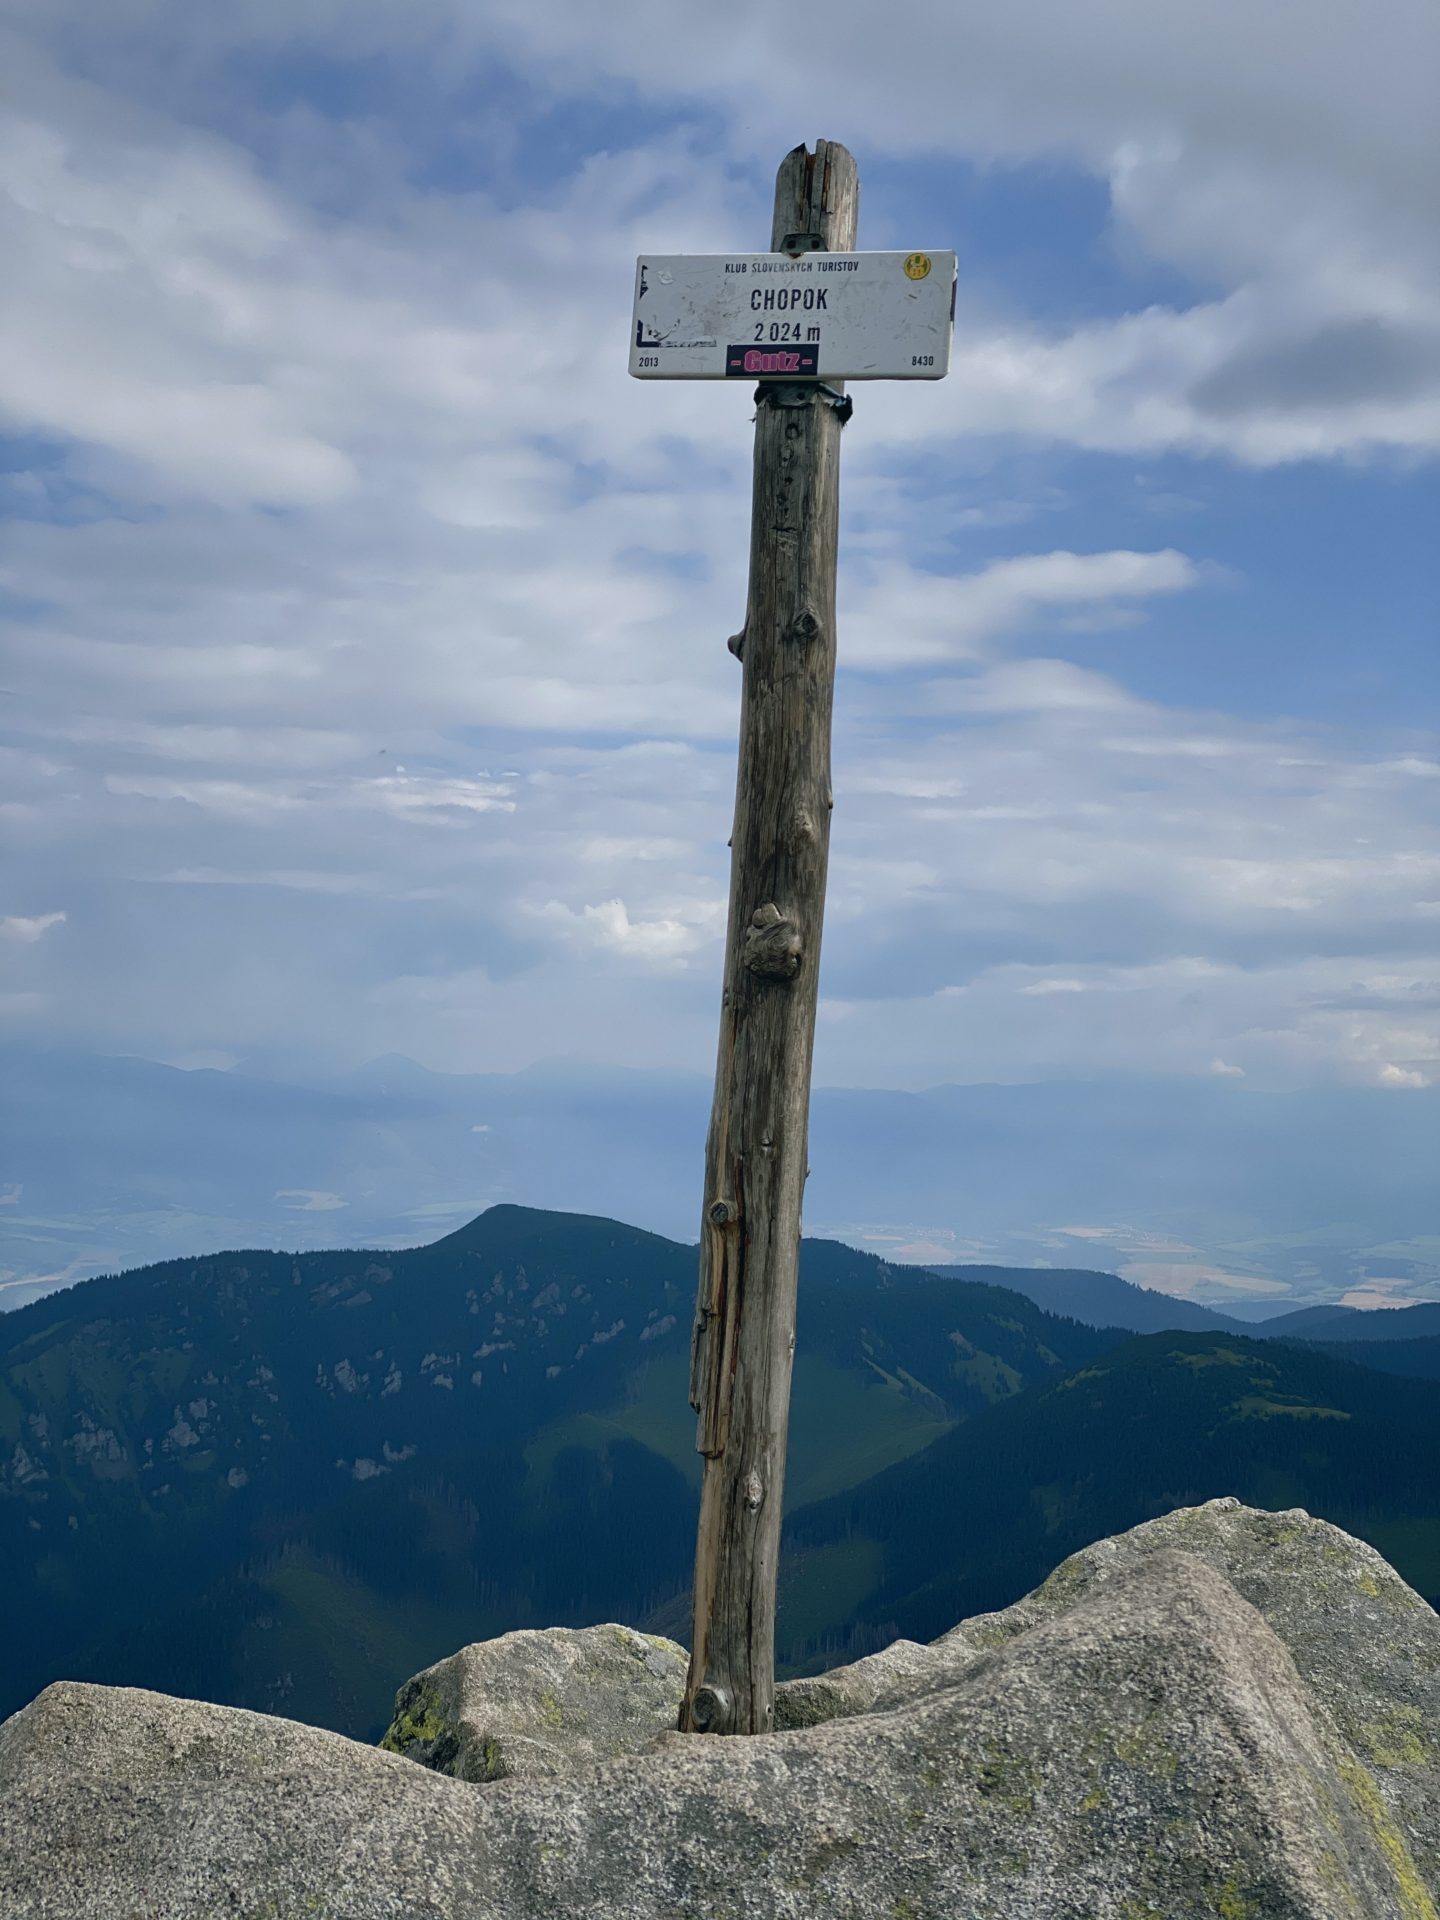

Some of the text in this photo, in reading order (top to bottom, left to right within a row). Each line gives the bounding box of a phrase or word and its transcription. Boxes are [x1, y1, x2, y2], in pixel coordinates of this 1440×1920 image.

[725, 263, 747, 273] KLUB
[817, 261, 859, 272] TURISTOV
[750, 288, 829, 310] CHOPOK
[807, 326, 821, 341] m
[638, 357, 659, 368] 2013
[911, 355, 934, 366] 8430
